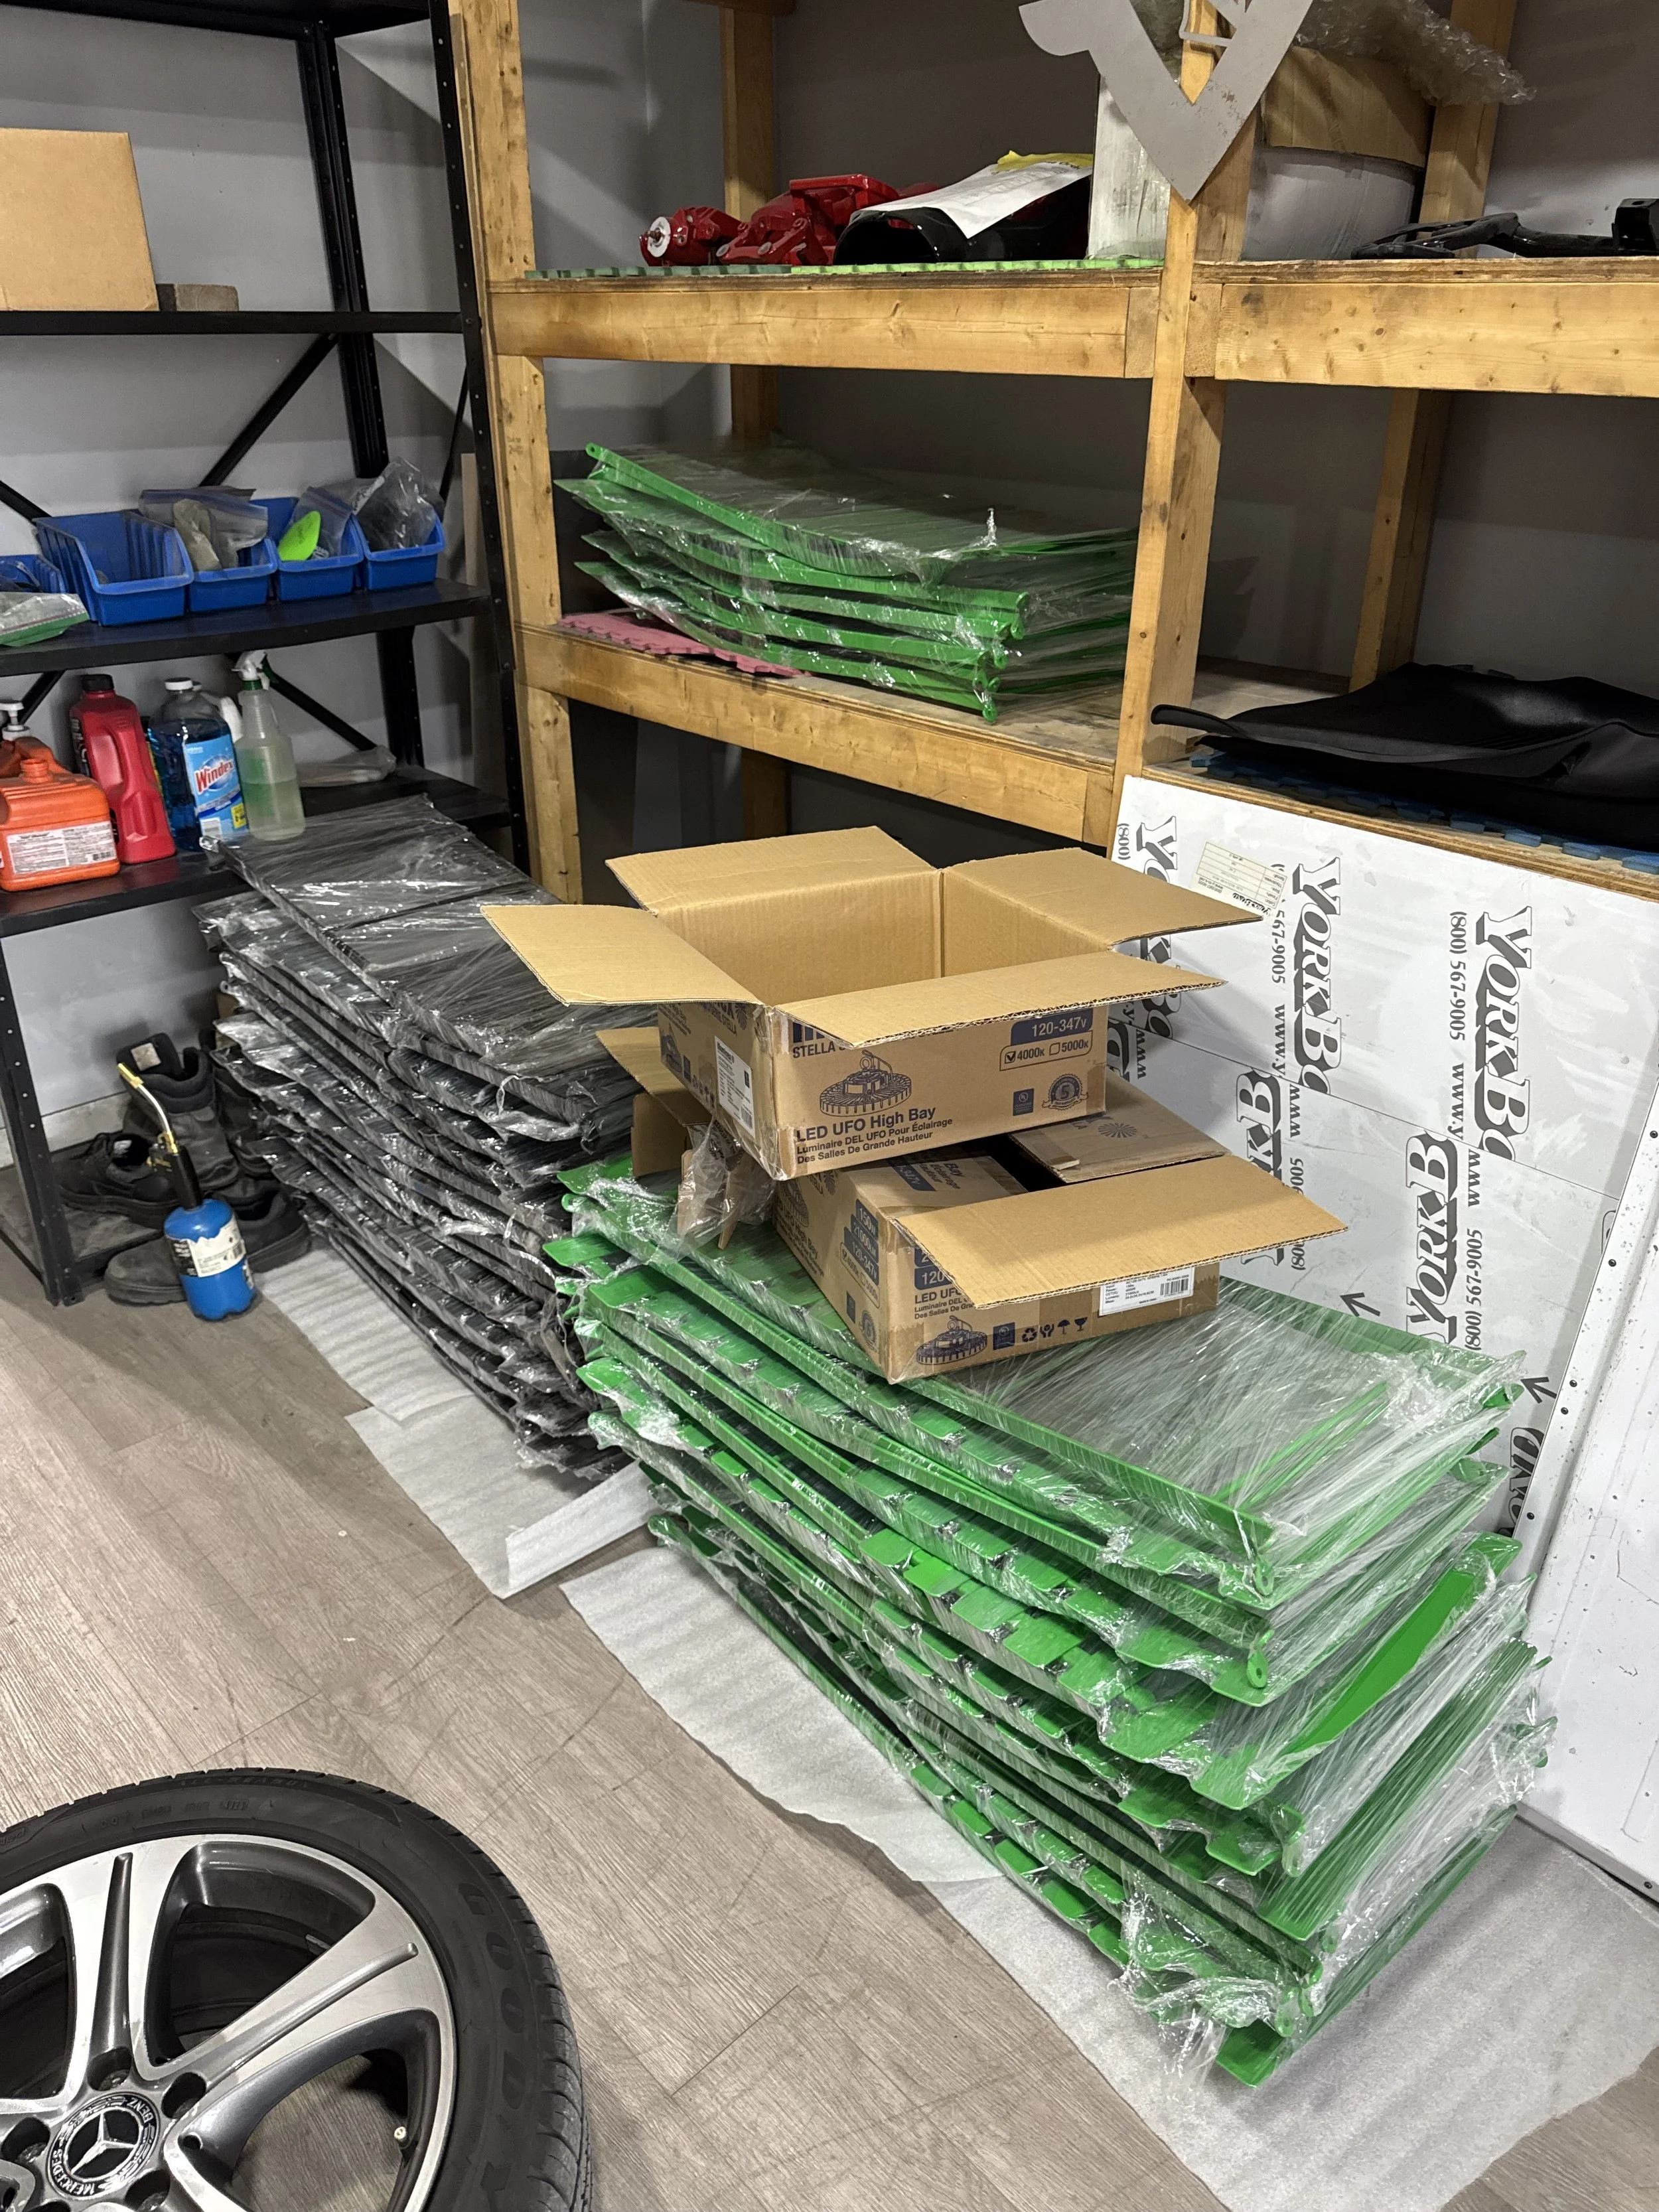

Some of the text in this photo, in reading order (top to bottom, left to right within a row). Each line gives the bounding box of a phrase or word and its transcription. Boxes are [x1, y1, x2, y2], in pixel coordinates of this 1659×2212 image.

[195, 761, 233, 794] Windex
[1118, 823, 1130, 860] (800)
[1449, 911, 1467, 954] (800)
[1449, 960, 1467, 1041] 567-9005
[792, 1041, 836, 1059] STELLA
[1017, 1039, 1089, 1061] 4000K 5000K
[796, 1107, 936, 1142] LED UFO High Bay
[1289, 1084, 1301, 1138] www
[797, 1118, 953, 1155] Luminaire DEL UFO Pour Éclairage
[797, 1131, 934, 1164] Des Salles De Grande Hauteur
[944, 1163, 966, 1178] Bay
[1465, 1150, 1483, 1350] (800) 567-9005 www
[914, 1291, 937, 1304] LED
[914, 1302, 947, 1313] Luminaire
[929, 1308, 949, 1317] Salles
[127, 2097, 154, 2123] BENZ
[52, 2148, 95, 2195] MERCEDES
